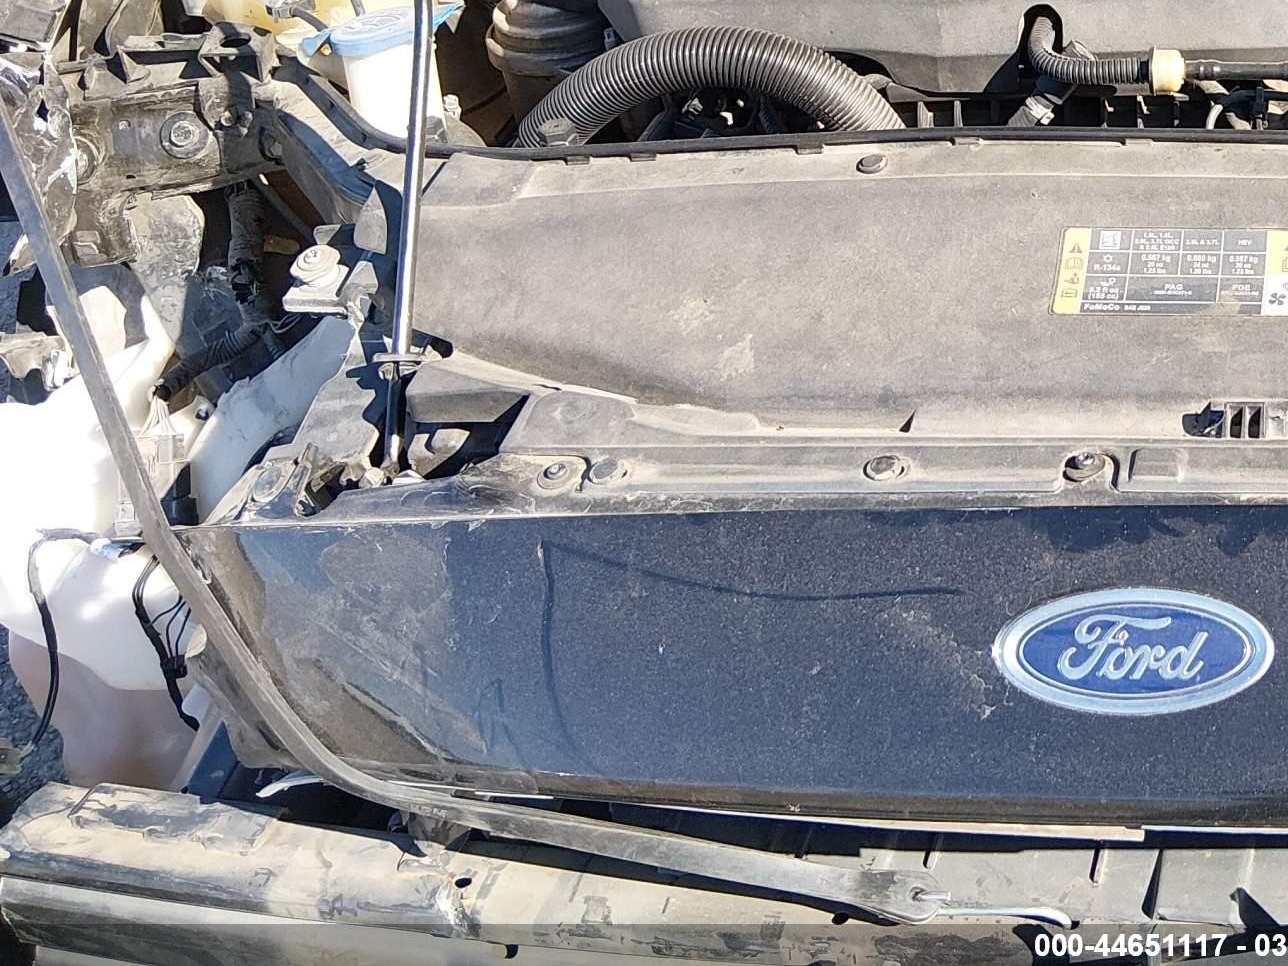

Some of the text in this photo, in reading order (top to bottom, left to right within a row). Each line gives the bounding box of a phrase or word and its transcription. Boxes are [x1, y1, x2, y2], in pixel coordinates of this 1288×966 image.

[1161, 253, 1171, 263] kg
[1207, 254, 1217, 264] kg
[1249, 255, 1259, 265] kg
[1094, 263, 1121, 272] R-134a
[1164, 283, 1184, 291] PAG
[1083, 303, 1121, 311] FoMoCo
[1057, 614, 1209, 680] Ford
